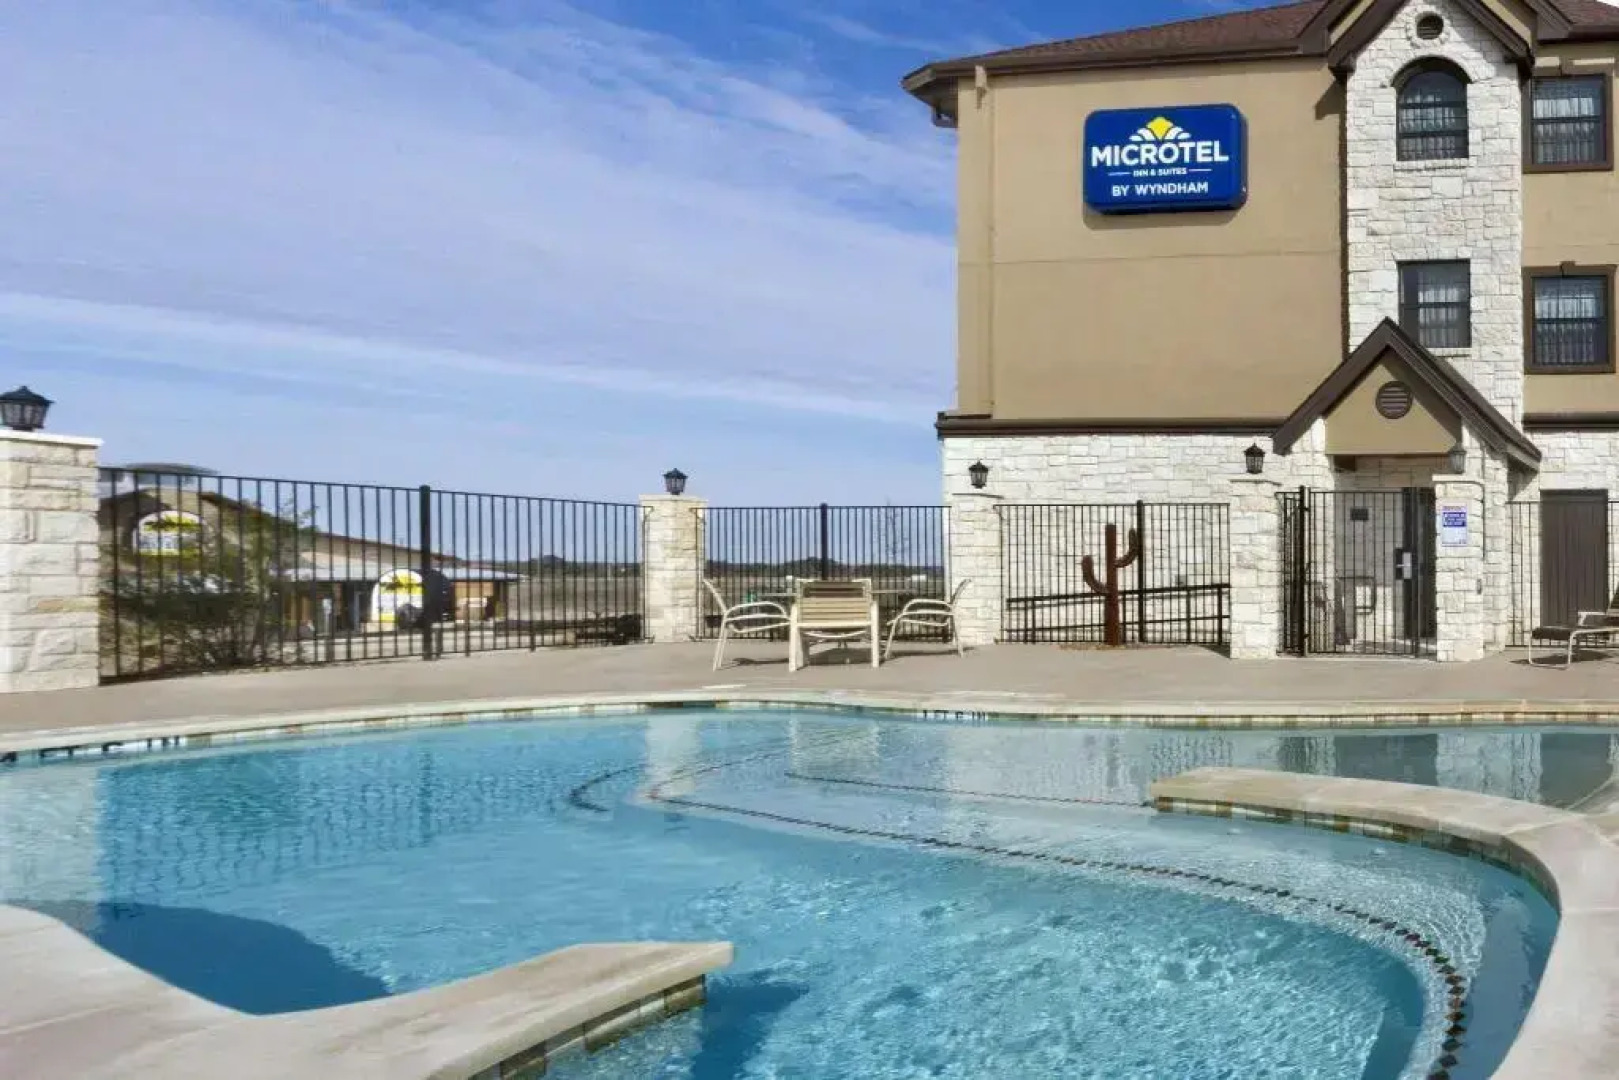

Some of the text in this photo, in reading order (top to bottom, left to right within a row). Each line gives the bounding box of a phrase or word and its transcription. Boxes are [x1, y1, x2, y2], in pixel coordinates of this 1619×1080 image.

[1091, 140, 1230, 167] MICROTEL
[1132, 169, 1149, 177] INN
[1158, 167, 1187, 176] SUITES
[1112, 181, 1209, 197] BY WYNDHAM
